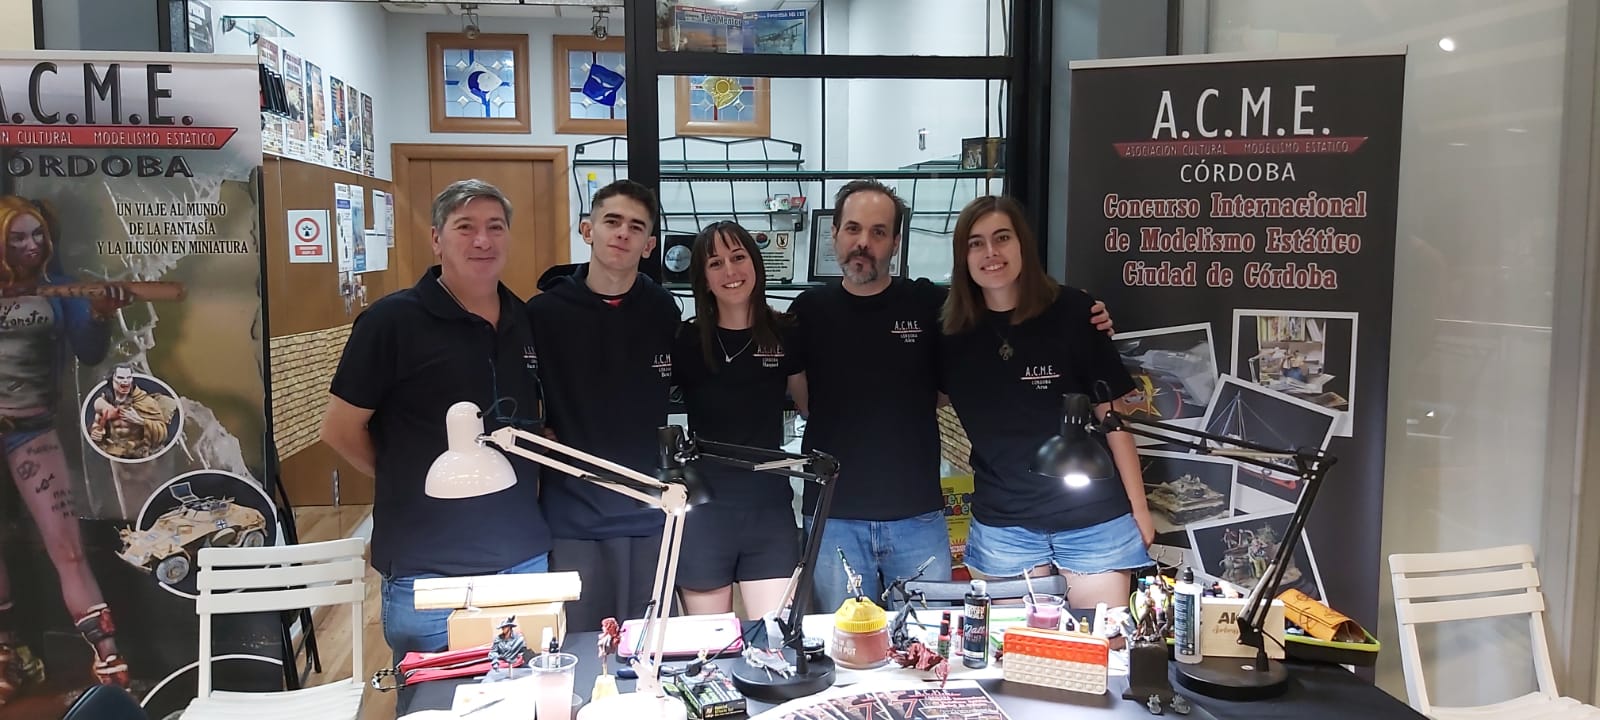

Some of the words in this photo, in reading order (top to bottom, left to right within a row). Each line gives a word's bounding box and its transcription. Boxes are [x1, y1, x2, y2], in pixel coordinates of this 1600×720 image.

[0, 61, 194, 125] .C.M.E.
[1151, 85, 1330, 140] A.C.M.E.
[17, 131, 74, 145] CULTURAL
[94, 131, 160, 145] MODELISMO
[167, 132, 216, 146] ESTATICO
[1125, 145, 1177, 157] ASOCIACION
[1183, 143, 1228, 156] CULTURAL
[1244, 141, 1300, 154] MODELISMO
[1305, 140, 1349, 153] ESTATICO
[7, 149, 194, 178] ÓRDOBA
[1180, 159, 1296, 182] CÓRDOBA
[117, 202, 132, 216] UN
[135, 202, 167, 217] VIAJE
[169, 202, 184, 216] AL
[186, 202, 226, 216] MUNDO
[1103, 193, 1200, 218] Concurso
[1210, 190, 1367, 219] Internacional
[129, 221, 145, 236] DE
[147, 222, 161, 236] LA
[164, 218, 216, 236] FANTASÍA
[97, 241, 105, 255] Y
[108, 240, 122, 255] LA
[125, 238, 170, 255] ILUSIÓN
[172, 240, 186, 254] EN
[188, 240, 249, 254] MINIATURA
[1105, 227, 1130, 252] de
[1140, 226, 1255, 252] Modelismo
[1265, 226, 1361, 254] Estático
[1123, 261, 1197, 286] Ciudad
[1207, 261, 1234, 287] de
[1244, 262, 1338, 290] Córdoba
[894, 320, 921, 331] A.C.M.E.
[1025, 365, 1057, 377] A.C.M.E.
